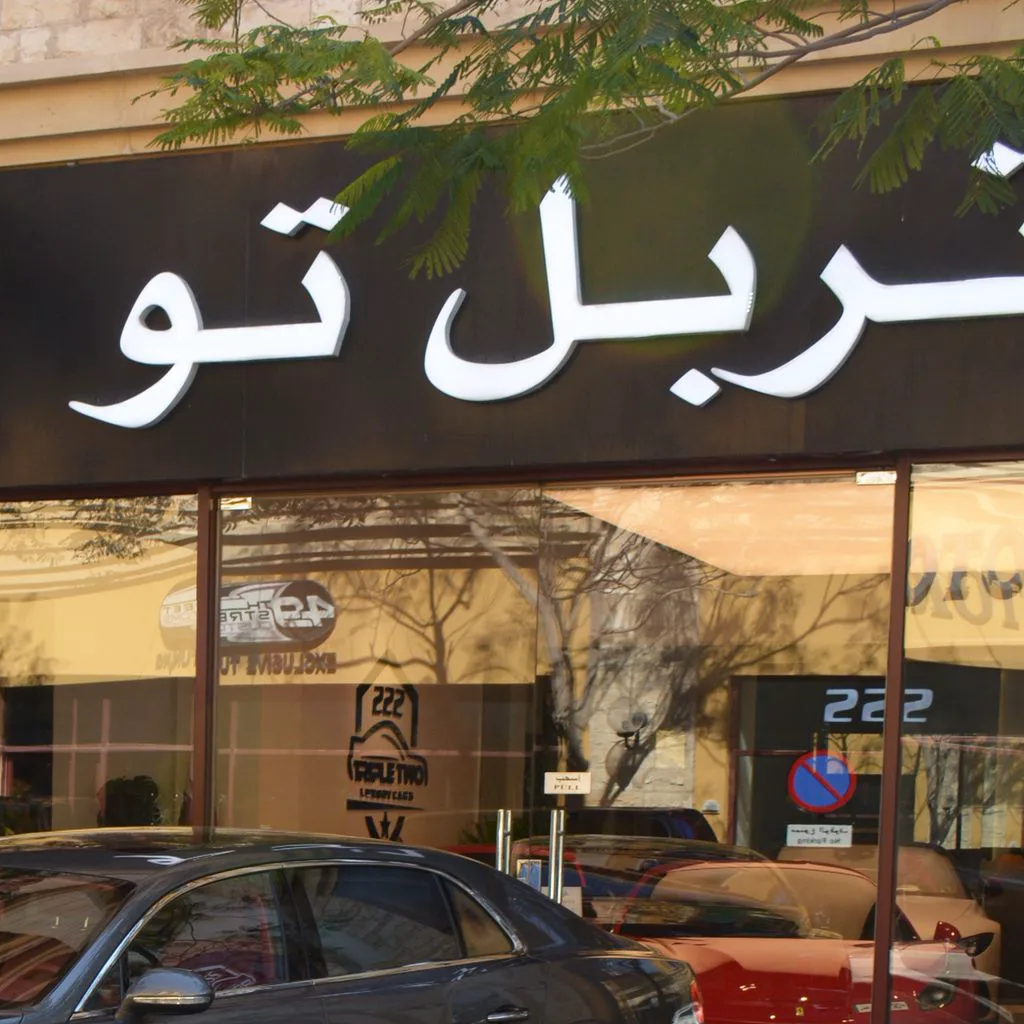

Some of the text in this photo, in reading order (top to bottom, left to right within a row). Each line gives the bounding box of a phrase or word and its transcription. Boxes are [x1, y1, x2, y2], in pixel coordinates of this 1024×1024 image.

[68, 195, 351, 430] تو
[372, 686, 404, 718] 222
[824, 688, 933, 722] 222
